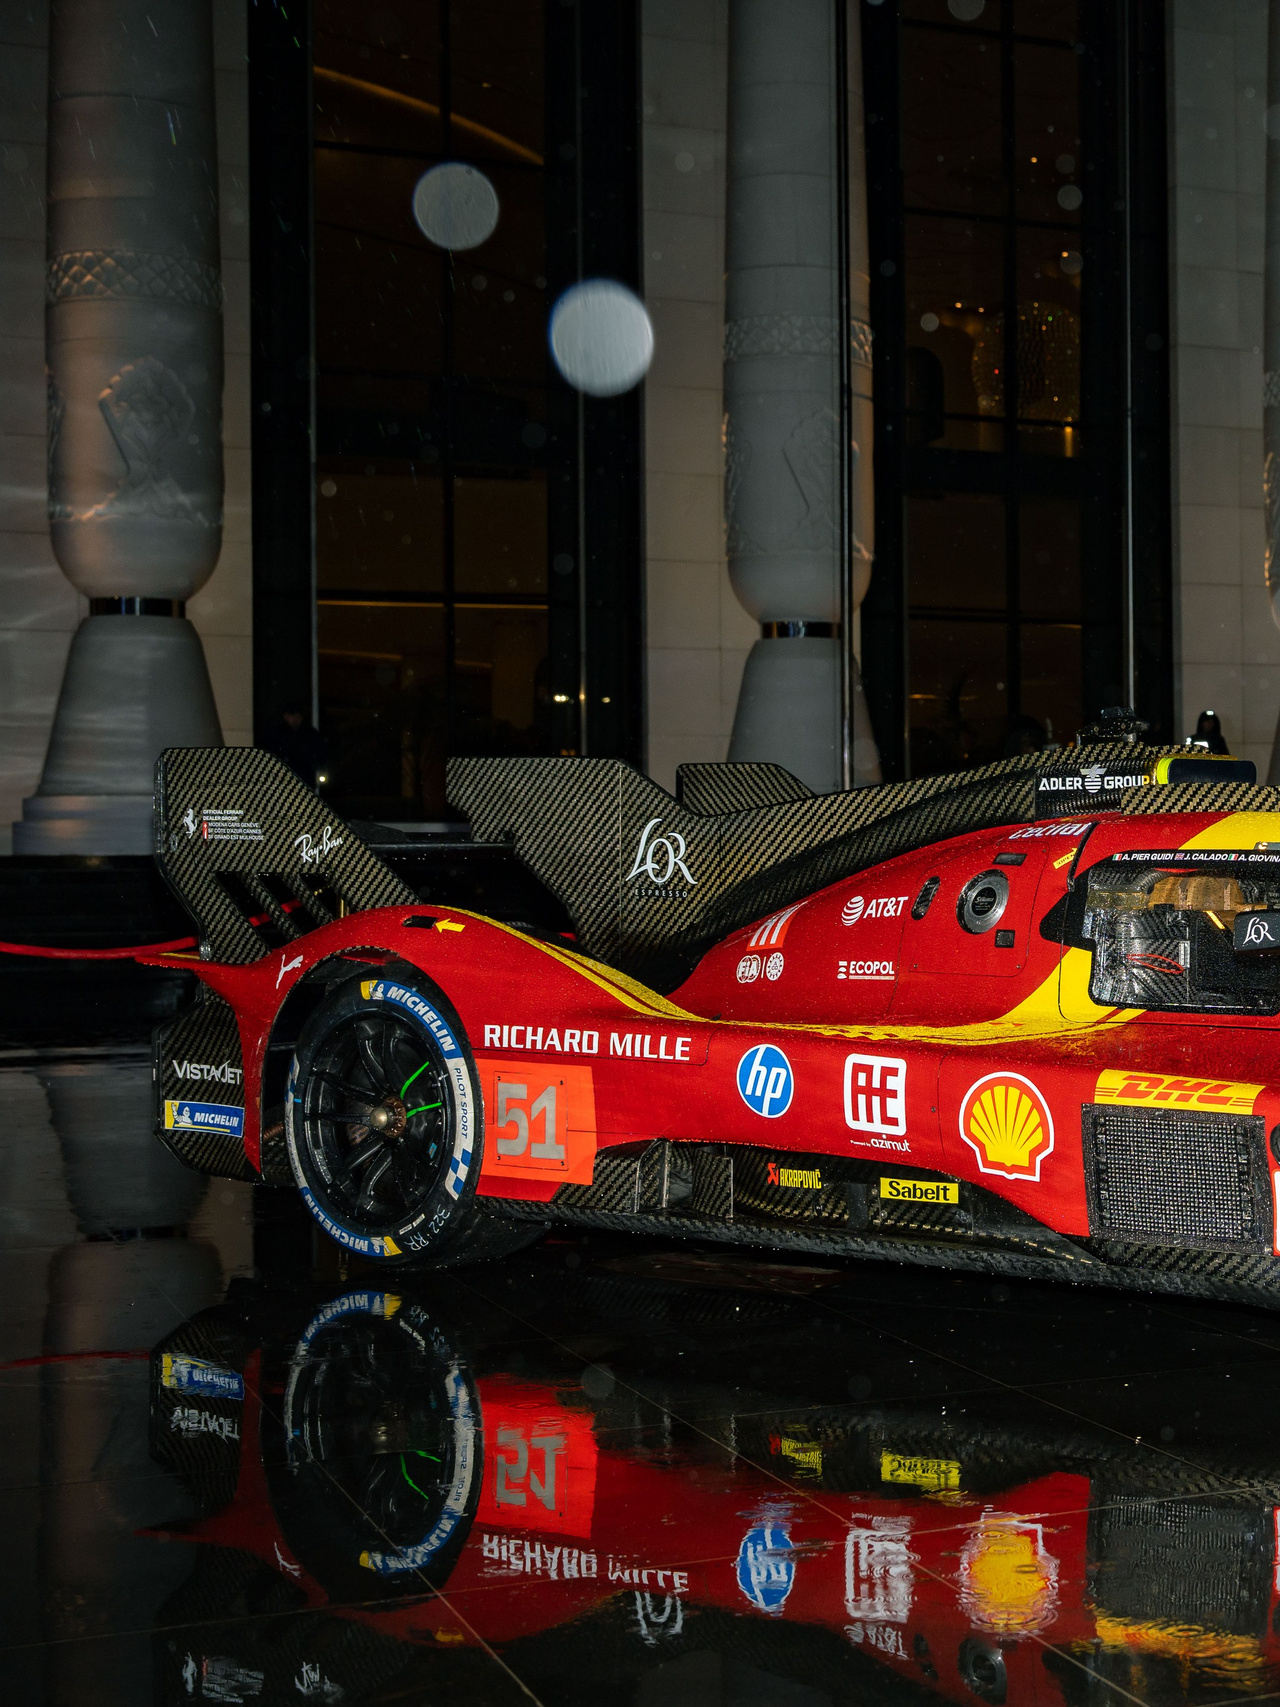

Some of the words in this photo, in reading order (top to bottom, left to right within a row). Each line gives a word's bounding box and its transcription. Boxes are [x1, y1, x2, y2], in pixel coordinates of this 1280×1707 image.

[1038, 777, 1083, 791] ADLER
[1103, 775, 1150, 790] GROUP
[1122, 853, 1131, 861] A.
[1131, 853, 1151, 861] PIER
[1151, 853, 1174, 861] GUIDI
[1192, 853, 1229, 861] CALADO
[1238, 854, 1248, 862] A.
[635, 889, 688, 898] ESPRESSO
[863, 896, 909, 919] AT&T
[849, 960, 896, 975] ECOPOL
[386, 985, 457, 1053] MICHELIN
[484, 1024, 600, 1054] RICHARD
[609, 1032, 692, 1061] MILLE
[172, 1060, 243, 1085] VISTAJET
[453, 1067, 468, 1101] PILOT
[745, 1045, 788, 1116] hp
[1115, 1074, 1234, 1106] DHL
[193, 1112, 240, 1128] MICHELIN
[459, 1100, 470, 1140] SPORT
[496, 1081, 566, 1161] 51
[870, 1134, 912, 1153] azimut
[888, 1180, 951, 1203] Sabelt
[304, 1193, 369, 1253] MICHELIN
